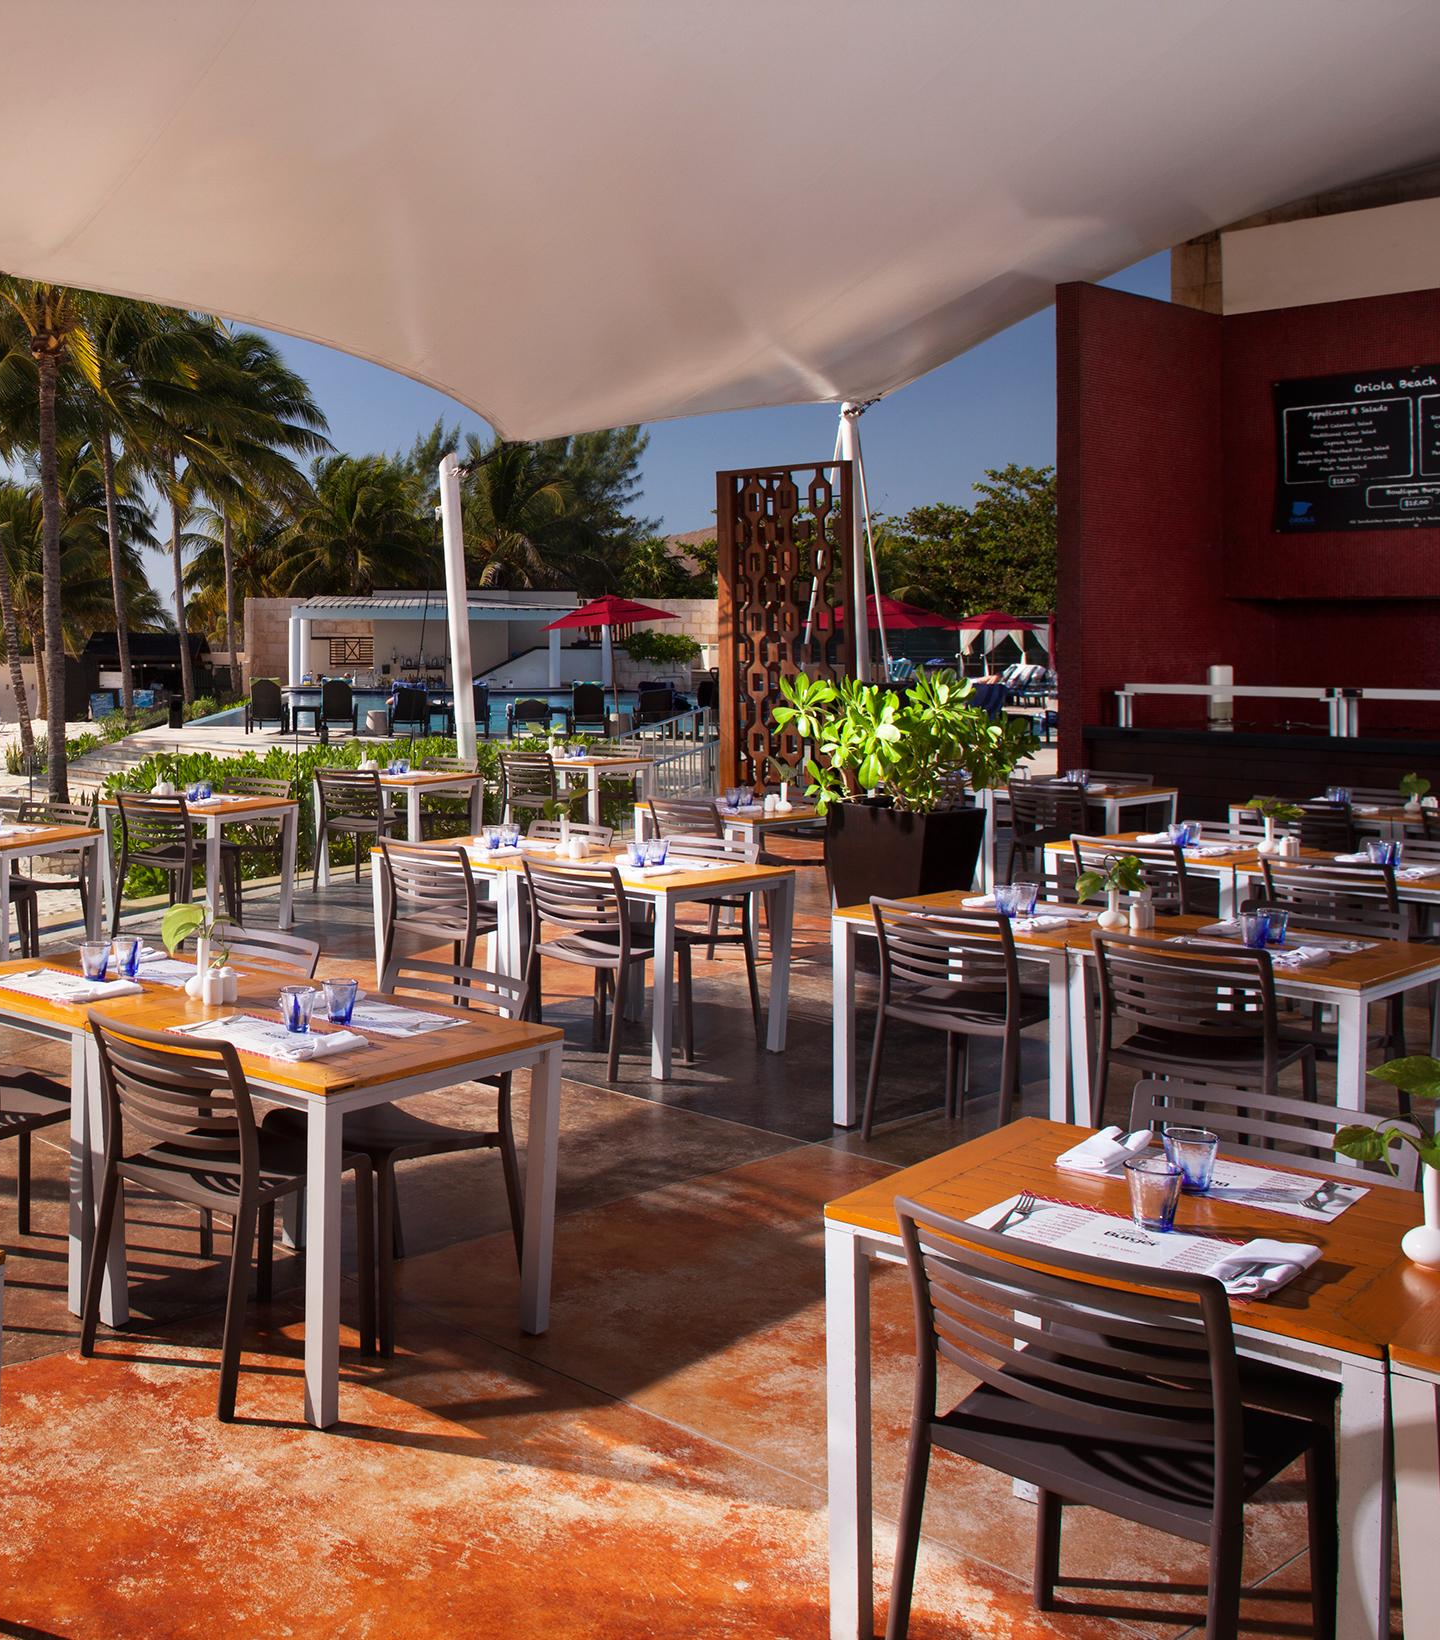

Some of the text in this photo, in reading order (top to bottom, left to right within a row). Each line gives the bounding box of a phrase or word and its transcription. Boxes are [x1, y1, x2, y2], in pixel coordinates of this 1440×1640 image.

[1354, 376, 1437, 393] Oriola Beach
[1360, 405, 1389, 414] Salads
[1104, 1230, 1156, 1247] Burger
